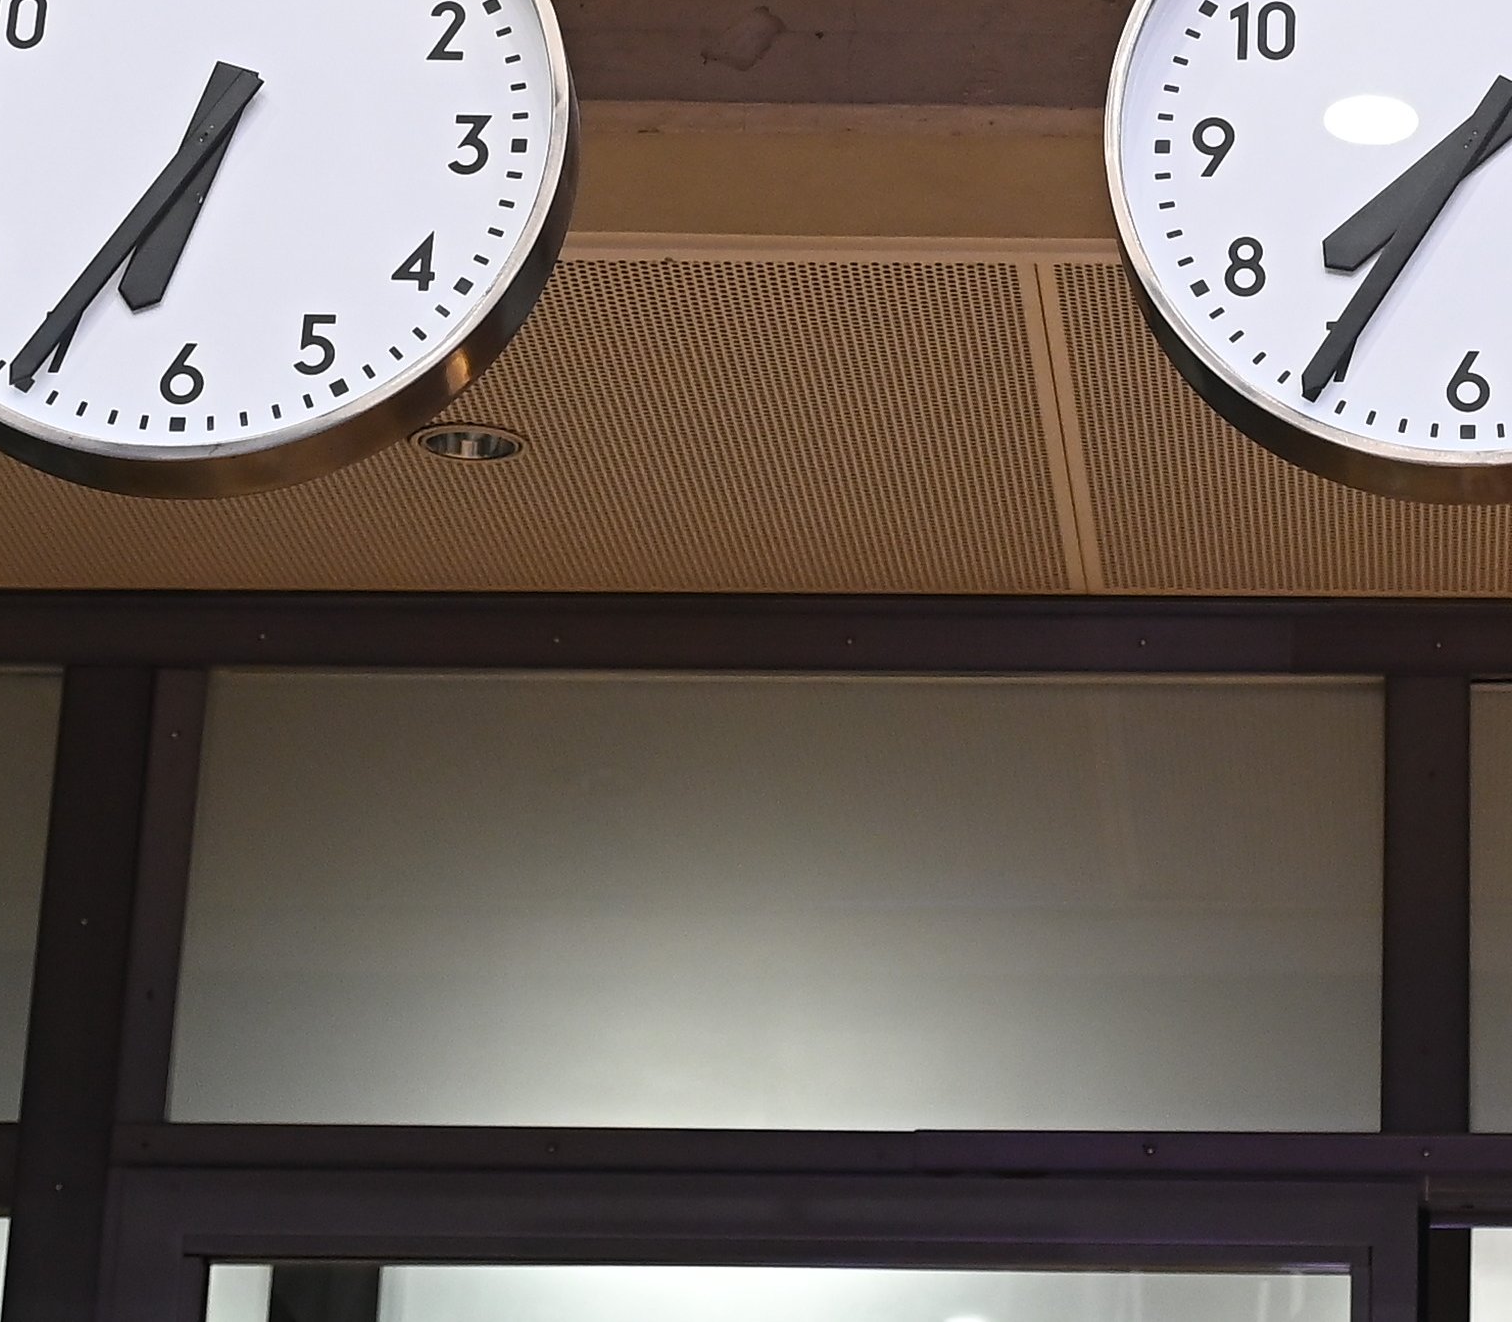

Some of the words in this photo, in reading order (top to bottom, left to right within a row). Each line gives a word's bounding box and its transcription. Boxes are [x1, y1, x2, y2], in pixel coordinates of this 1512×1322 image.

[426, 0, 466, 61] 2
[1229, 1, 1296, 61] 10
[447, 114, 493, 175] 3
[1192, 117, 1235, 178] 9
[390, 231, 436, 292] 4
[1224, 236, 1266, 297] 8
[159, 342, 205, 405] 6
[293, 313, 337, 376] 5
[1446, 350, 1491, 413] 6
